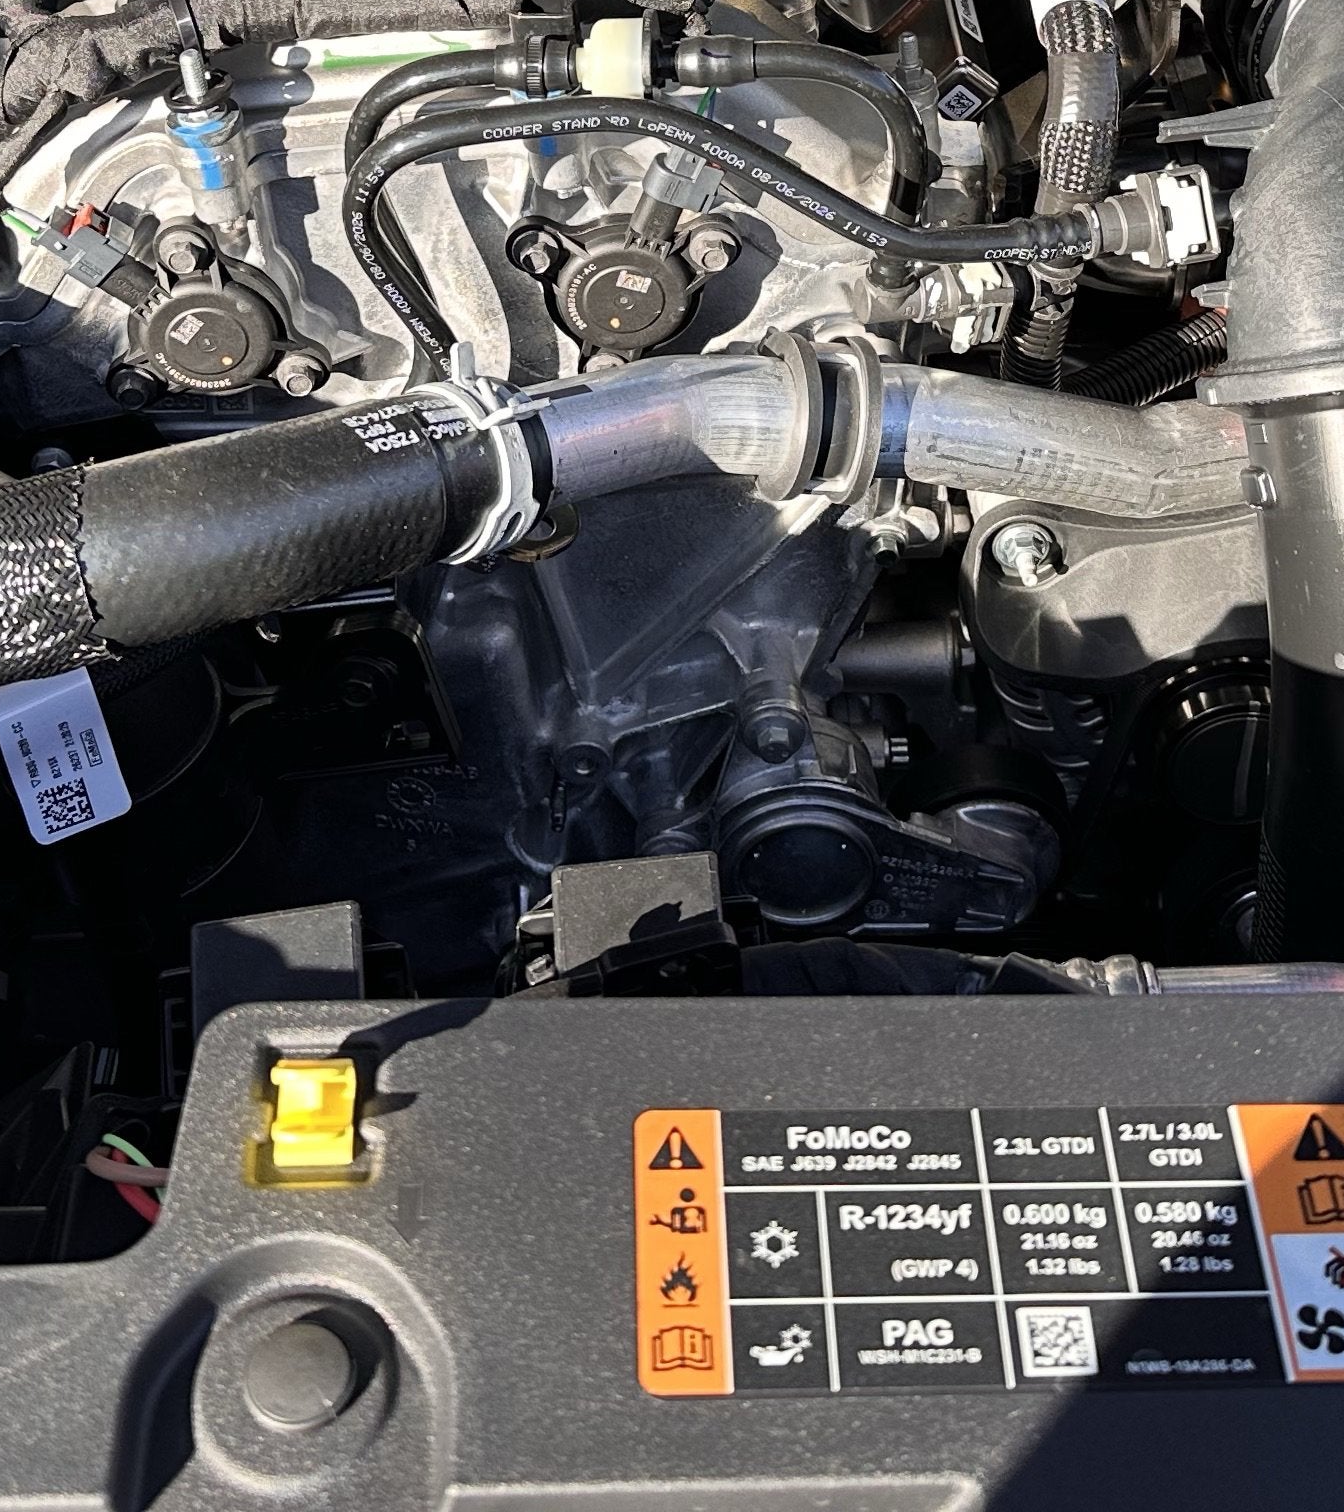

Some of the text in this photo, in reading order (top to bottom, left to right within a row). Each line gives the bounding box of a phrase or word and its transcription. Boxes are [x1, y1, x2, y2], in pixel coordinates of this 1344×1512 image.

[482, 122, 543, 140] COOPER
[637, 117, 697, 144] LoPERM
[701, 140, 746, 171] 4000A
[750, 166, 836, 221] 08/06/2026
[352, 211, 387, 282] 08/06/2026
[786, 1125, 912, 1150] FoMoCo
[1117, 1122, 1166, 1141] 2.7L
[1176, 1122, 1223, 1140] 3.0L
[993, 1136, 1096, 1156] 2.3L GTDI
[741, 1154, 962, 1172] SAE J639 J2842 J2845
[1148, 1148, 1203, 1167] GTDI
[838, 1203, 973, 1235] R-1234yf
[1002, 1202, 1107, 1228] 0.600 kg
[1134, 1201, 1238, 1226] 0.580 kg
[1071, 1234, 1099, 1249] oz
[1207, 1232, 1232, 1246] oz
[891, 1258, 979, 1283] (GWP 4)
[1024, 1257, 1102, 1276] 1.32 lbs
[1159, 1256, 1234, 1274] 1.28 lbs
[881, 1318, 954, 1347] PAG
